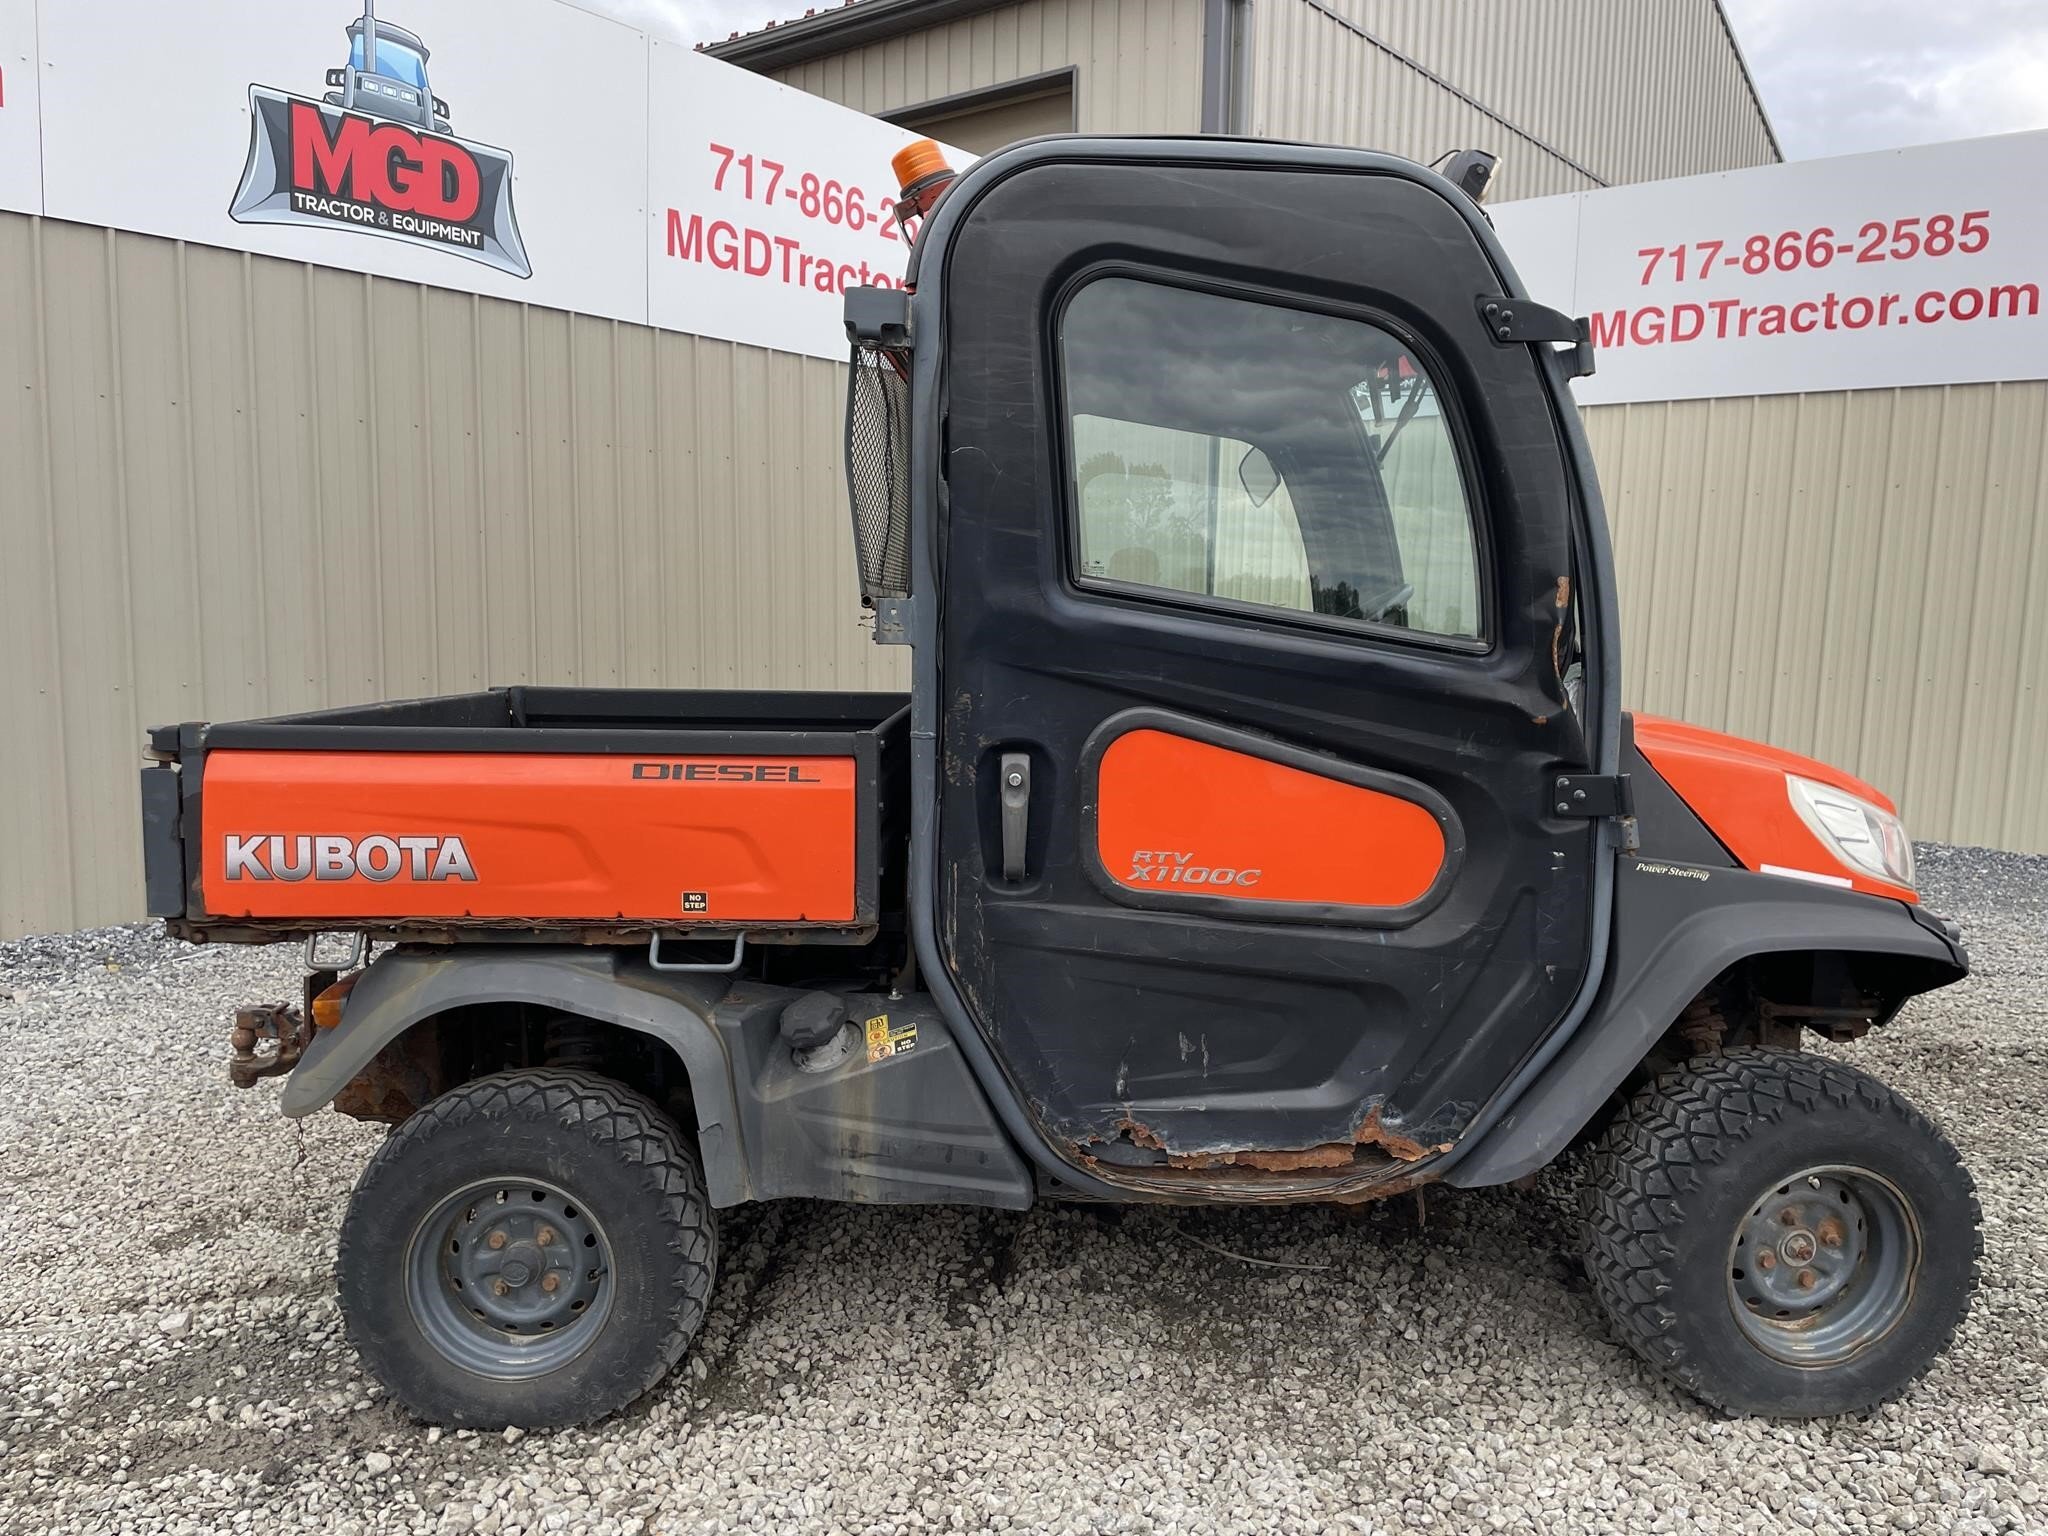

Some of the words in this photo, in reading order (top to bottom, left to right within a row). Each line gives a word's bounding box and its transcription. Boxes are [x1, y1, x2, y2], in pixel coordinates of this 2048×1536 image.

[291, 103, 481, 223] MGD
[294, 192, 375, 224] TRACTOR
[378, 209, 390, 227] &
[392, 213, 481, 246] EQUIPMENT
[1638, 210, 1990, 286] 717-866-2585
[1590, 282, 2040, 349] MGDTractor.com
[632, 763, 821, 783] DIESEL
[225, 834, 478, 882] KUBOTA
[1132, 850, 1194, 865] RTV
[1126, 864, 1262, 887] X1100C
[1636, 862, 1668, 874] Power
[1668, 867, 1711, 882] Steering
[689, 894, 702, 902] NO
[896, 1042, 916, 1052] STEP
